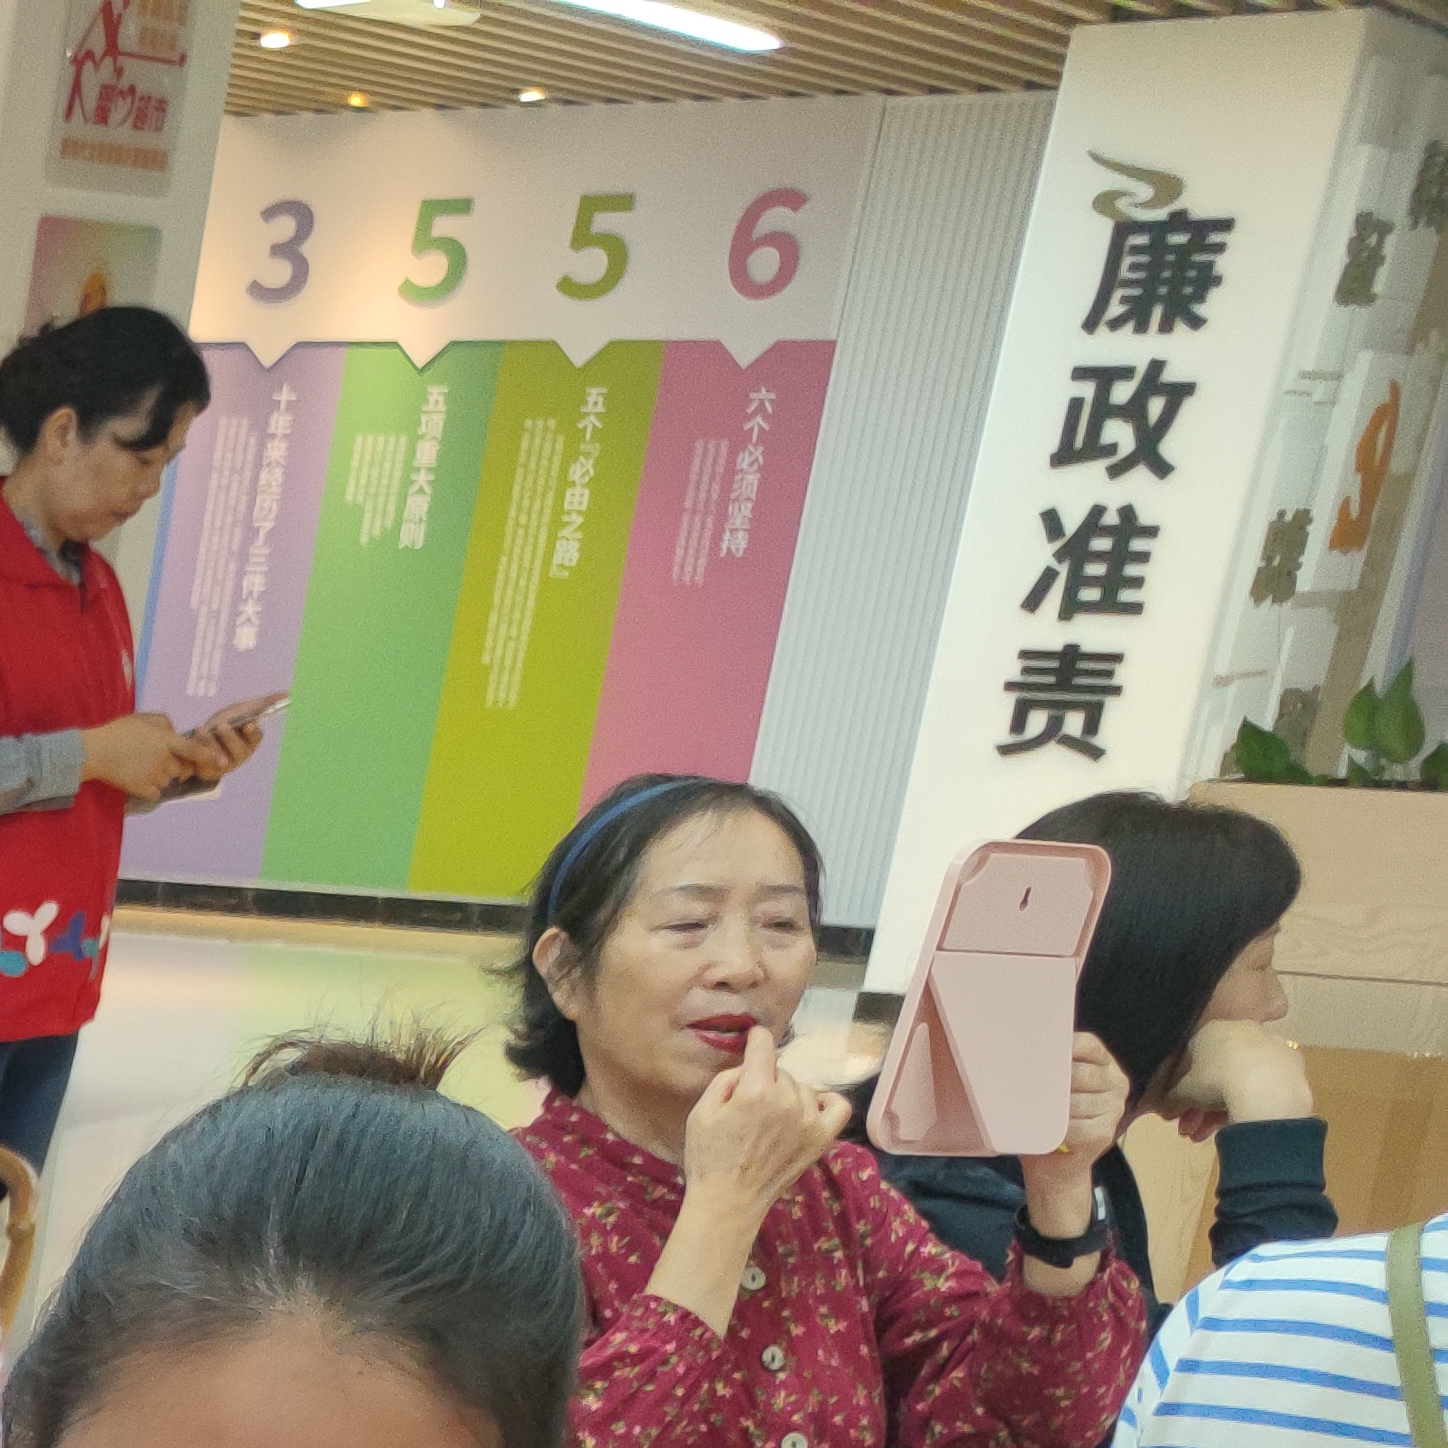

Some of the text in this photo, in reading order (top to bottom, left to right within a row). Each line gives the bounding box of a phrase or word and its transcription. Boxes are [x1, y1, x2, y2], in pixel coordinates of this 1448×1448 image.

[246, 187, 810, 304] 3 5 5 6
[398, 385, 449, 549] 五项重大原则
[719, 386, 776, 558] 六个必须坚持
[995, 209, 1235, 763] 廉政准责
